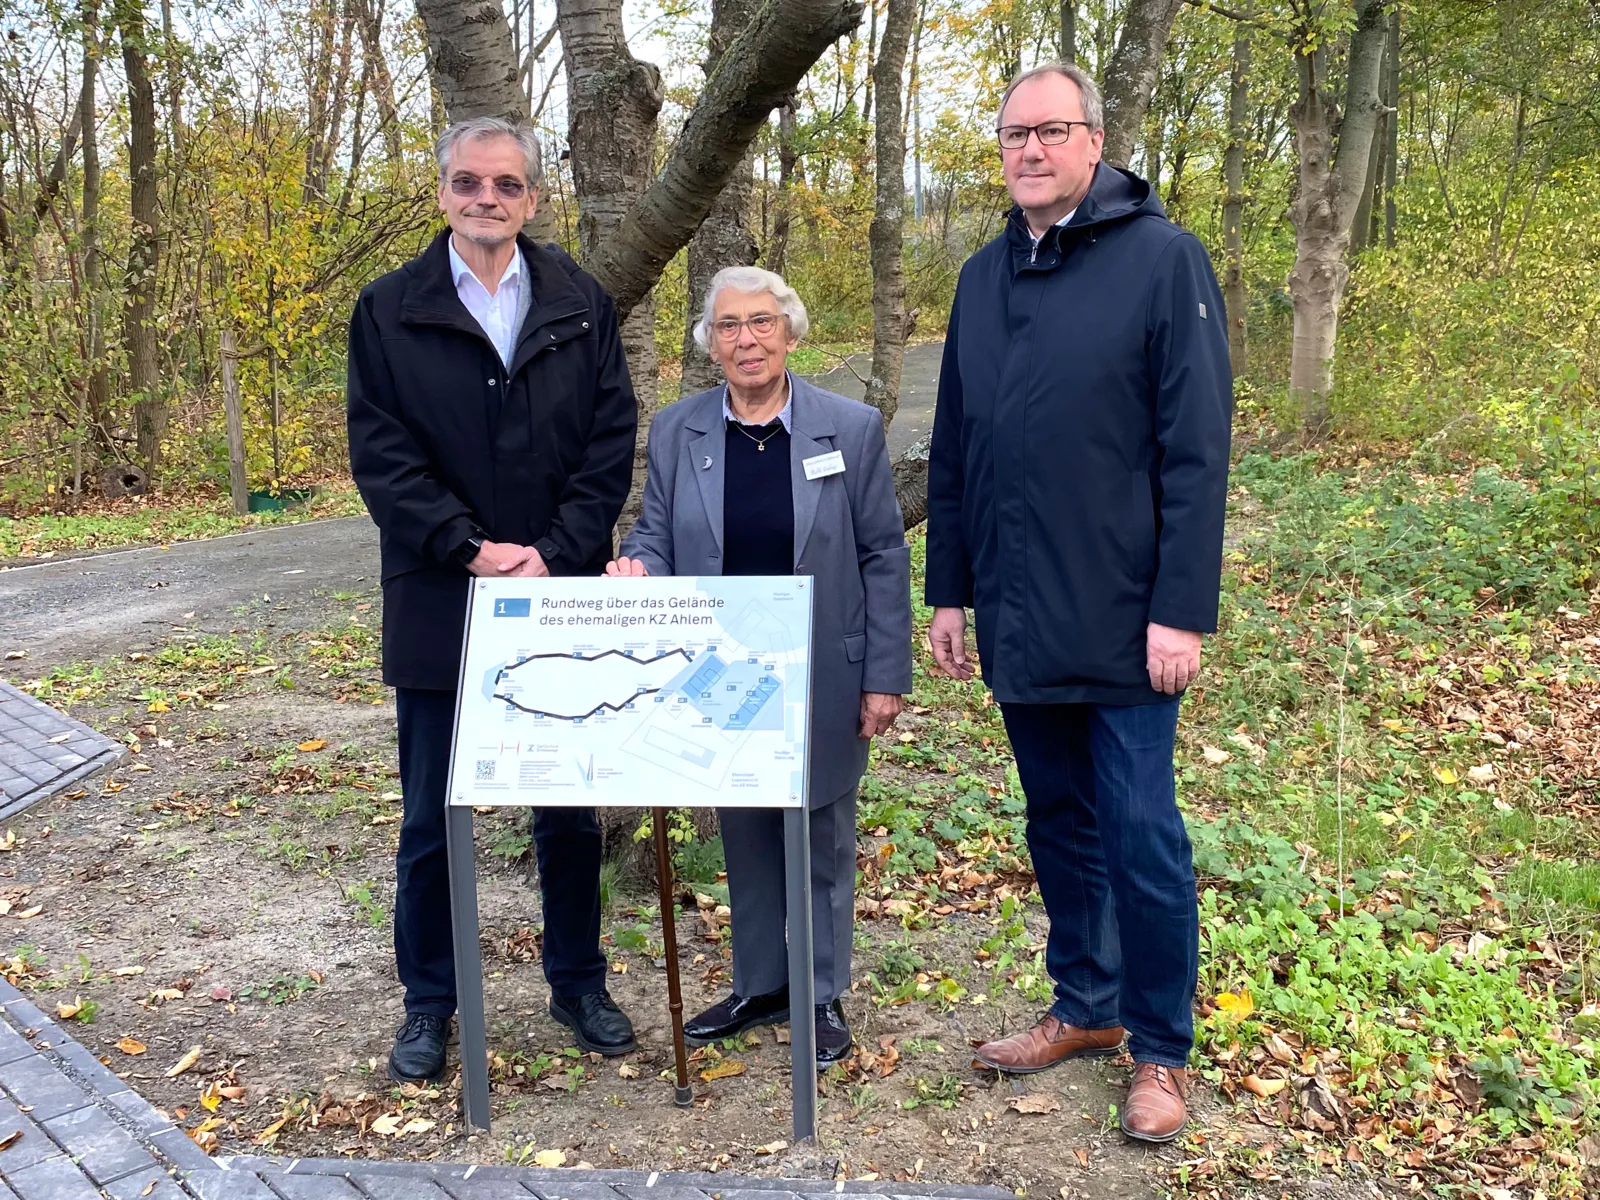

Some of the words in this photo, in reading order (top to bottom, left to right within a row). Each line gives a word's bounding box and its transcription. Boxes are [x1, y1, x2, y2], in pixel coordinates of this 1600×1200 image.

[498, 602, 506, 614] 1
[541, 597, 604, 611] Rundweg
[606, 597, 638, 609] über
[640, 597, 665, 609] das
[668, 596, 725, 609] Gelände
[539, 614, 564, 626] des
[567, 613, 646, 628] ehemaligen
[649, 613, 668, 625] KZ
[669, 613, 713, 625] Ahlem
